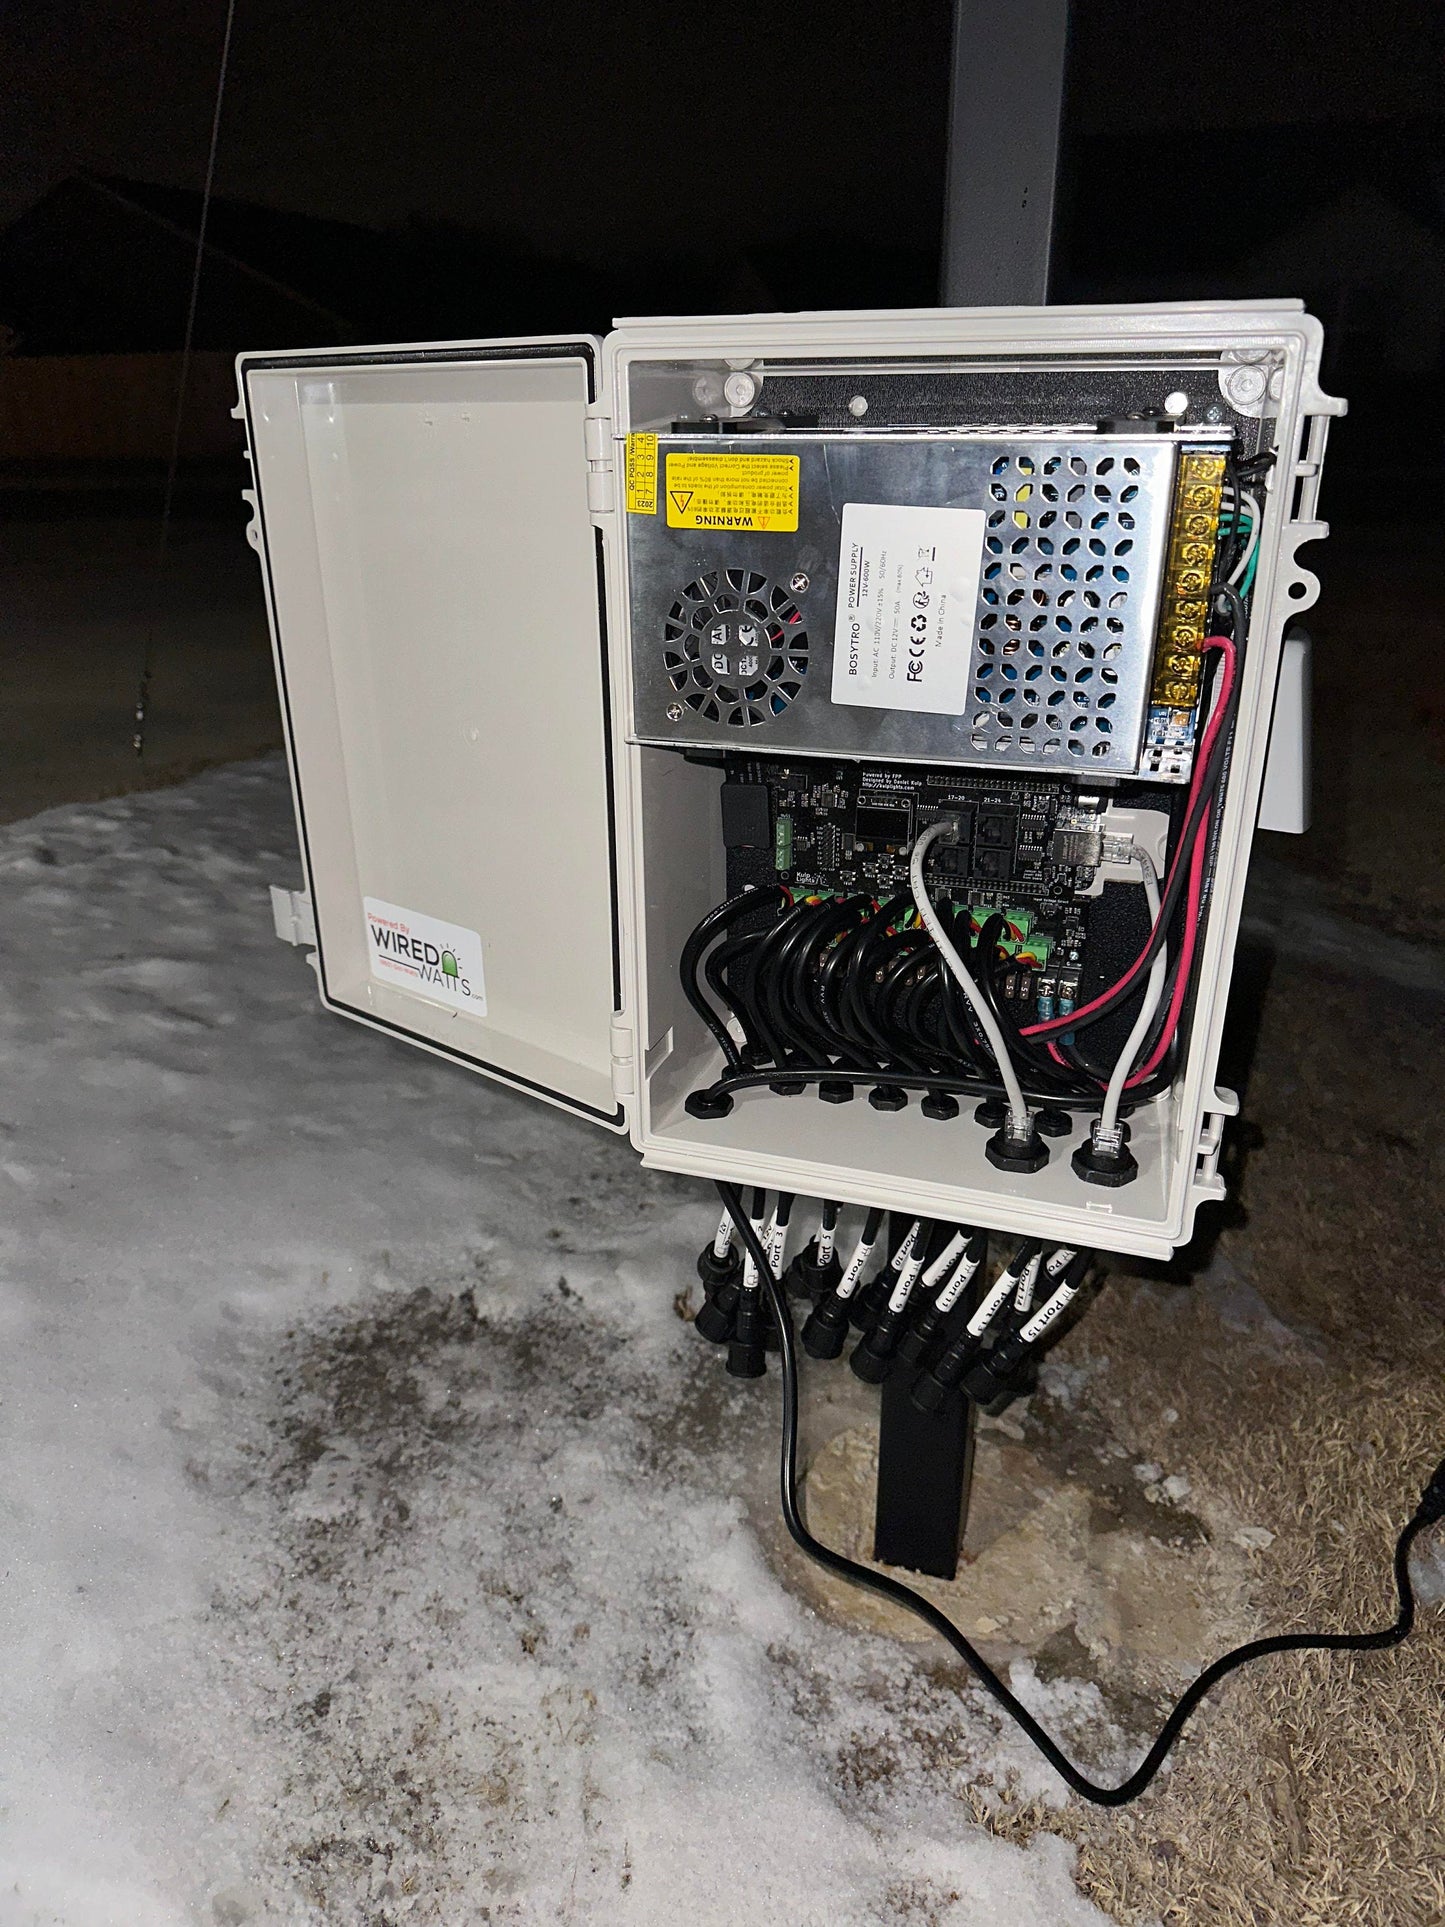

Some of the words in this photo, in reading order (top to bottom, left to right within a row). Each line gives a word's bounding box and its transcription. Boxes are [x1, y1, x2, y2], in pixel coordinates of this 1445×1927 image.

[647, 435, 654, 446] 10
[629, 480, 635, 491] QC
[695, 515, 753, 526] WARNING
[850, 543, 859, 575] SUPPLY
[862, 561, 871, 597] 12V-600W
[848, 577, 857, 609] POWER
[938, 595, 947, 615] China
[849, 623, 861, 676] BOSYTRO
[891, 642, 898, 653] DC
[935, 628, 943, 648] Made
[873, 647, 880, 658] AC
[368, 912, 399, 930] Powered
[400, 923, 411, 936] By
[371, 925, 440, 967] WIRED
[418, 965, 472, 997] WATTS
[901, 1234, 916, 1255] Port
[771, 1245, 782, 1268] Port
[896, 1257, 904, 1266] 10
[848, 1259, 864, 1282] Port
[1019, 1268, 1031, 1294] Port
[900, 1274, 916, 1297] Port
[949, 1274, 967, 1297] Port
[942, 1299, 950, 1307] 11
[986, 1292, 1007, 1318] Port
[1039, 1300, 1065, 1326] Port
[1028, 1326, 1041, 1338] 15
